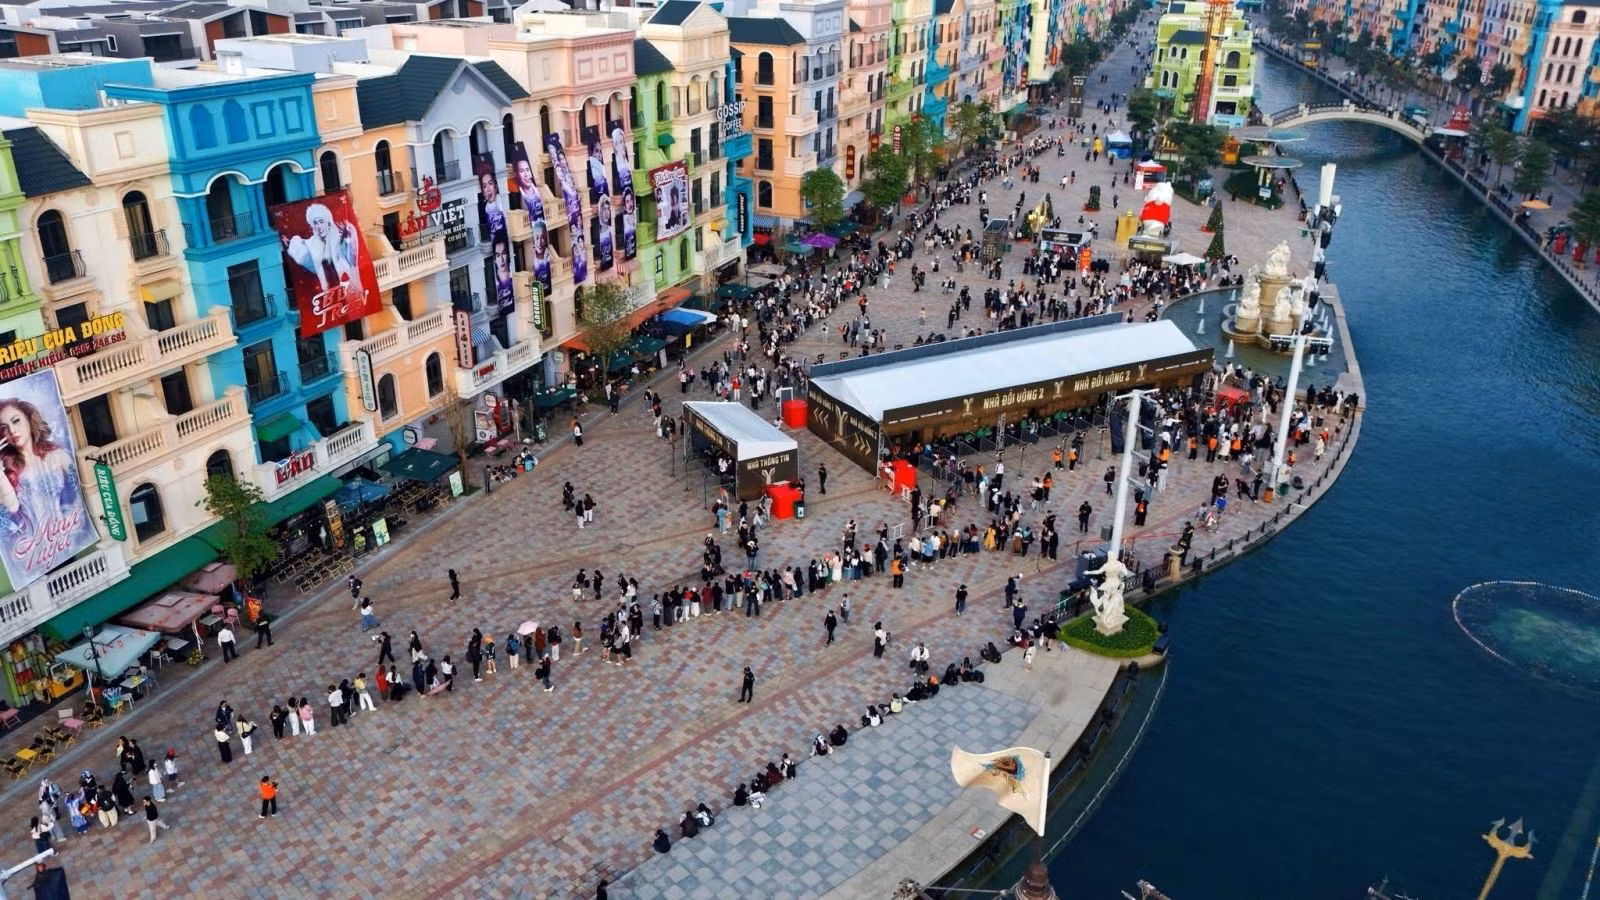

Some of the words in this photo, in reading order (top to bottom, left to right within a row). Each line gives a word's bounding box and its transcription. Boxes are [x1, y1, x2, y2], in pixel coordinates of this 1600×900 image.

[716, 101, 745, 120] GOSSIP
[723, 118, 743, 131] COFFEE
[431, 203, 465, 226] VIỆT
[43, 327, 76, 350] CUA
[1074, 376, 1089, 391] NHÀ
[1125, 371, 1131, 381] 2
[983, 394, 1000, 409] NHÀ
[1039, 388, 1045, 399] 2
